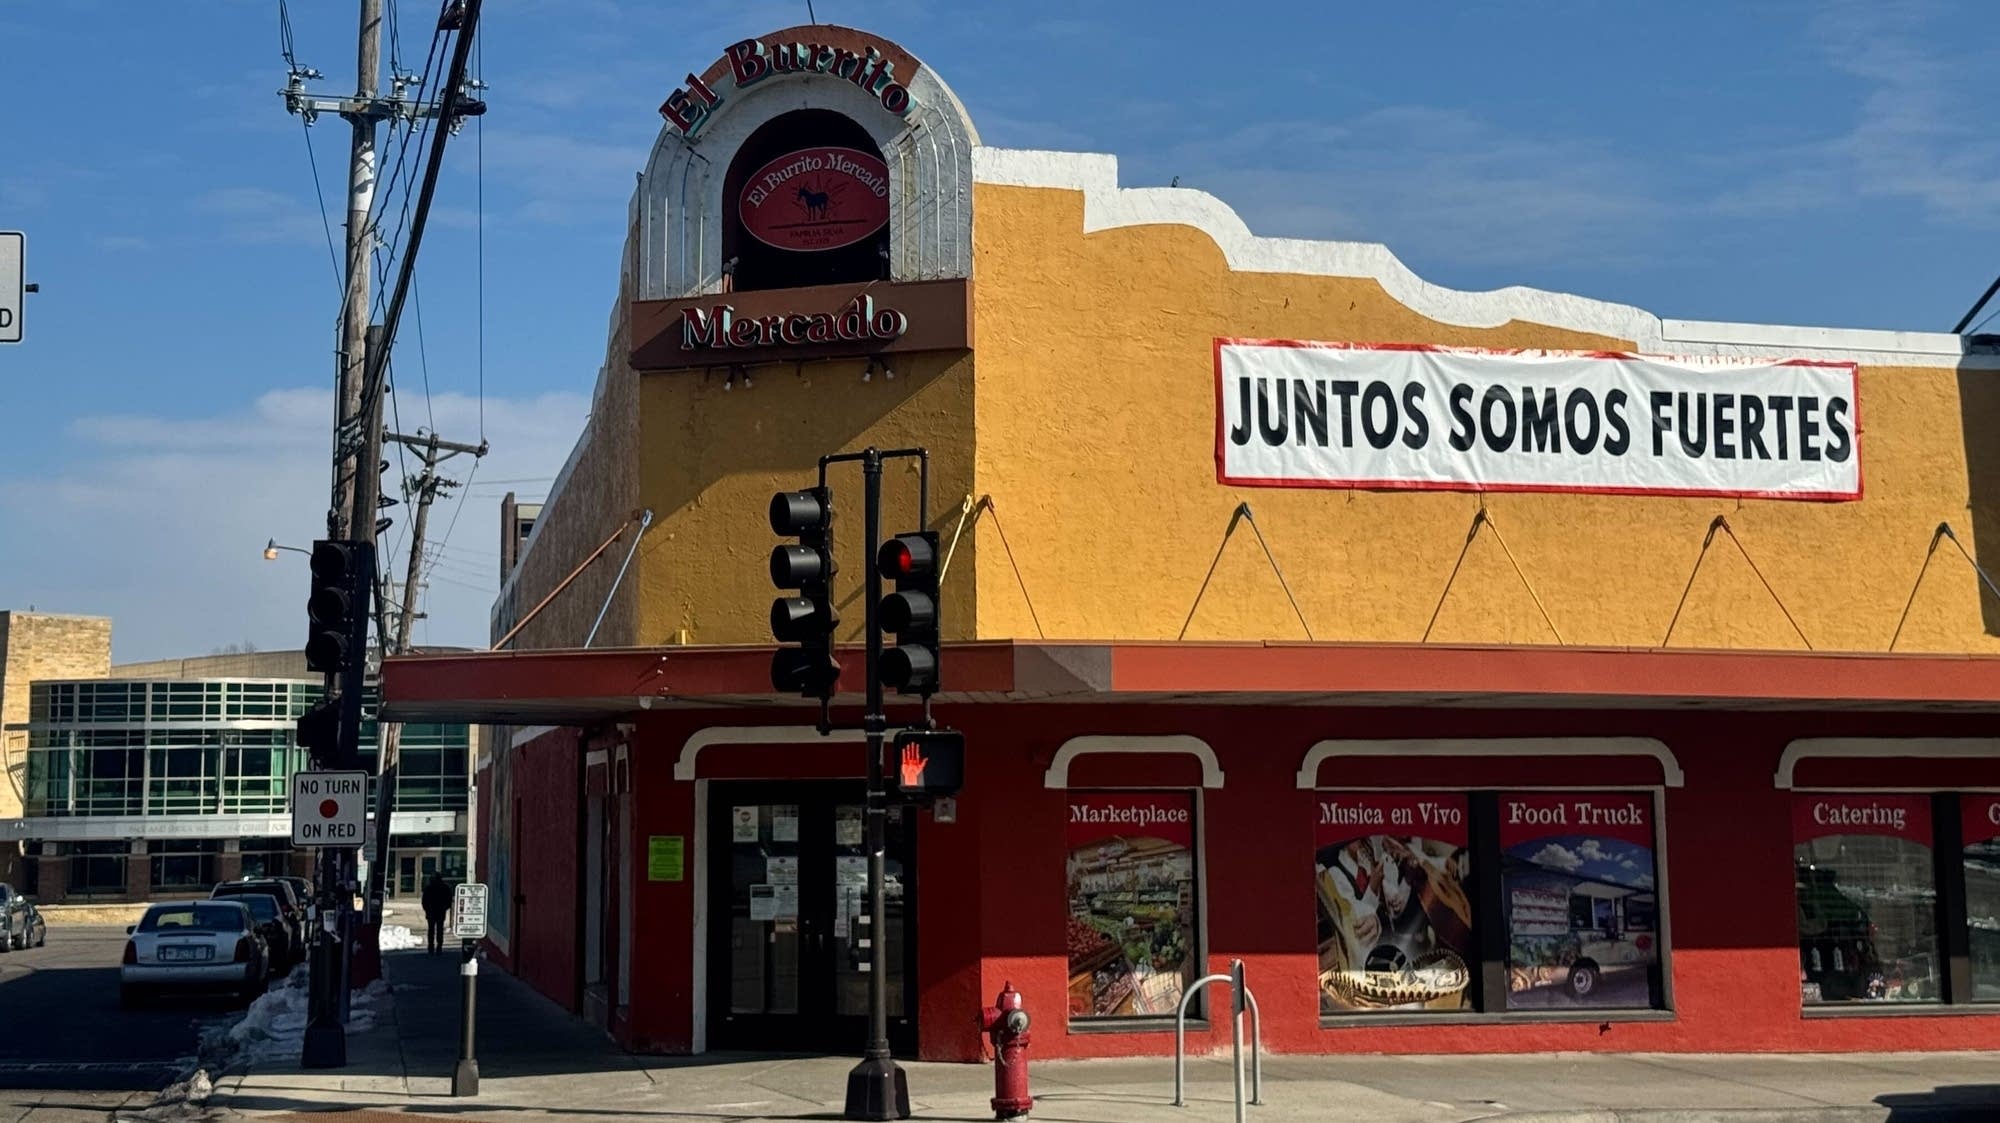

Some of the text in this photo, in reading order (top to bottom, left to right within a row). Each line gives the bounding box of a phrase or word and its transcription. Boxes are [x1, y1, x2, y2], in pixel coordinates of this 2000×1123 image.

[659, 38, 914, 136] El Burrito
[747, 152, 887, 208] El Burrito Mercado
[680, 294, 907, 350] Mercado
[1230, 376, 1851, 463] JUNTOS SOMOS FUERTES
[300, 780, 360, 794] NO TURN
[1070, 804, 1188, 827] Marketplace
[1319, 802, 1461, 825] Musica en Vivo
[1508, 802, 1643, 825] Food Truck
[1813, 802, 1905, 830] Catering
[302, 823, 356, 838] ON RED
